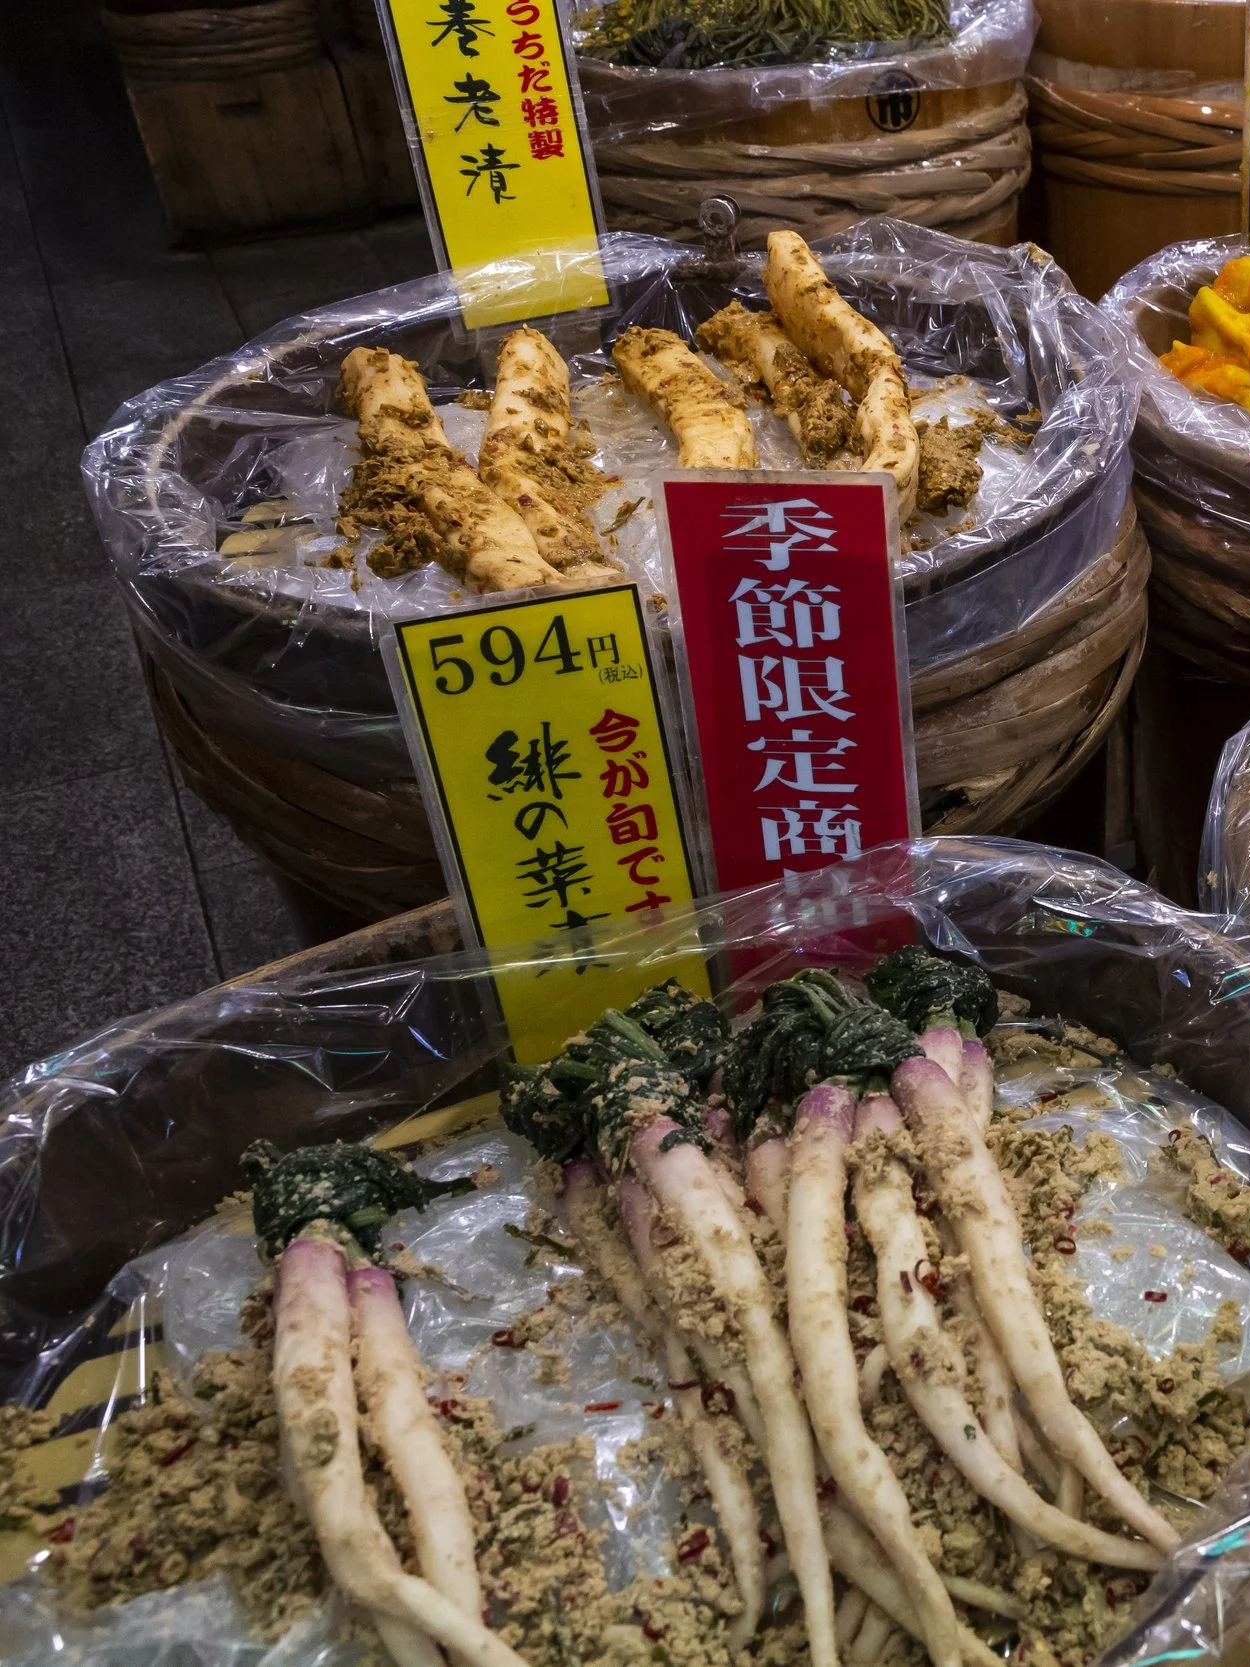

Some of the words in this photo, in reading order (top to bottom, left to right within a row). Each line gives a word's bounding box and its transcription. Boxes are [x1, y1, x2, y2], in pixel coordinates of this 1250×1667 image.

[506, 0, 565, 161] うちだ特製
[429, 614, 621, 696] 594円
